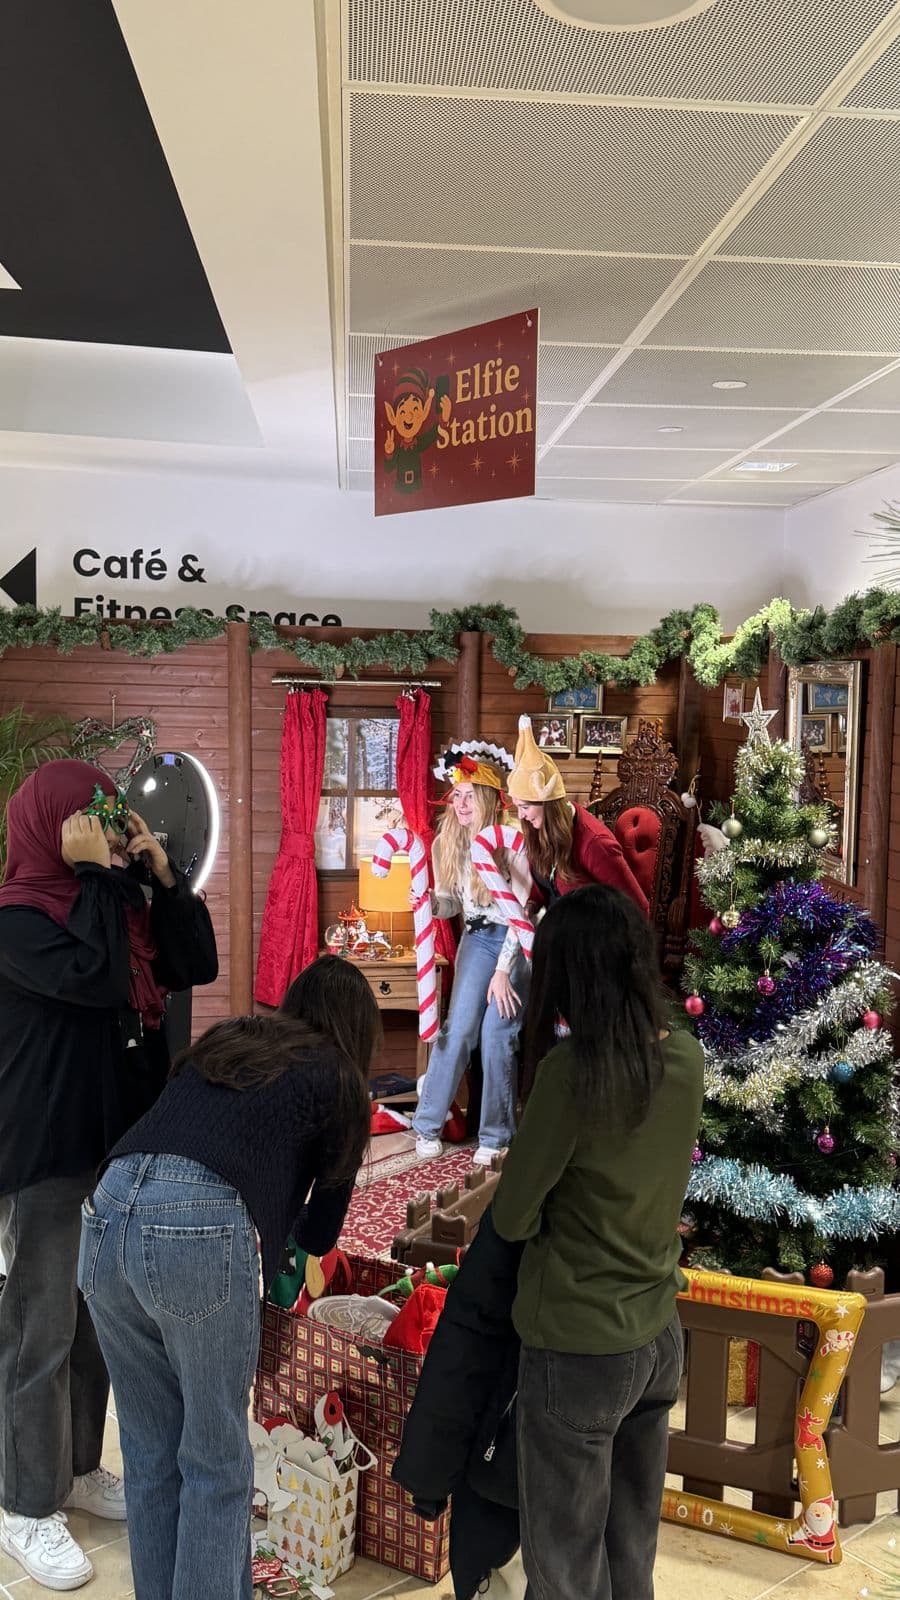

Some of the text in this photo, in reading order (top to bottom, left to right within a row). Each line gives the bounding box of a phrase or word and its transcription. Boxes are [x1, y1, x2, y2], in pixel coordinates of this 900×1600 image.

[455, 358, 520, 404] Elfie
[436, 403, 534, 449] Station
[73, 549, 206, 583] Café &
[689, 1280, 813, 1317] hristmas
